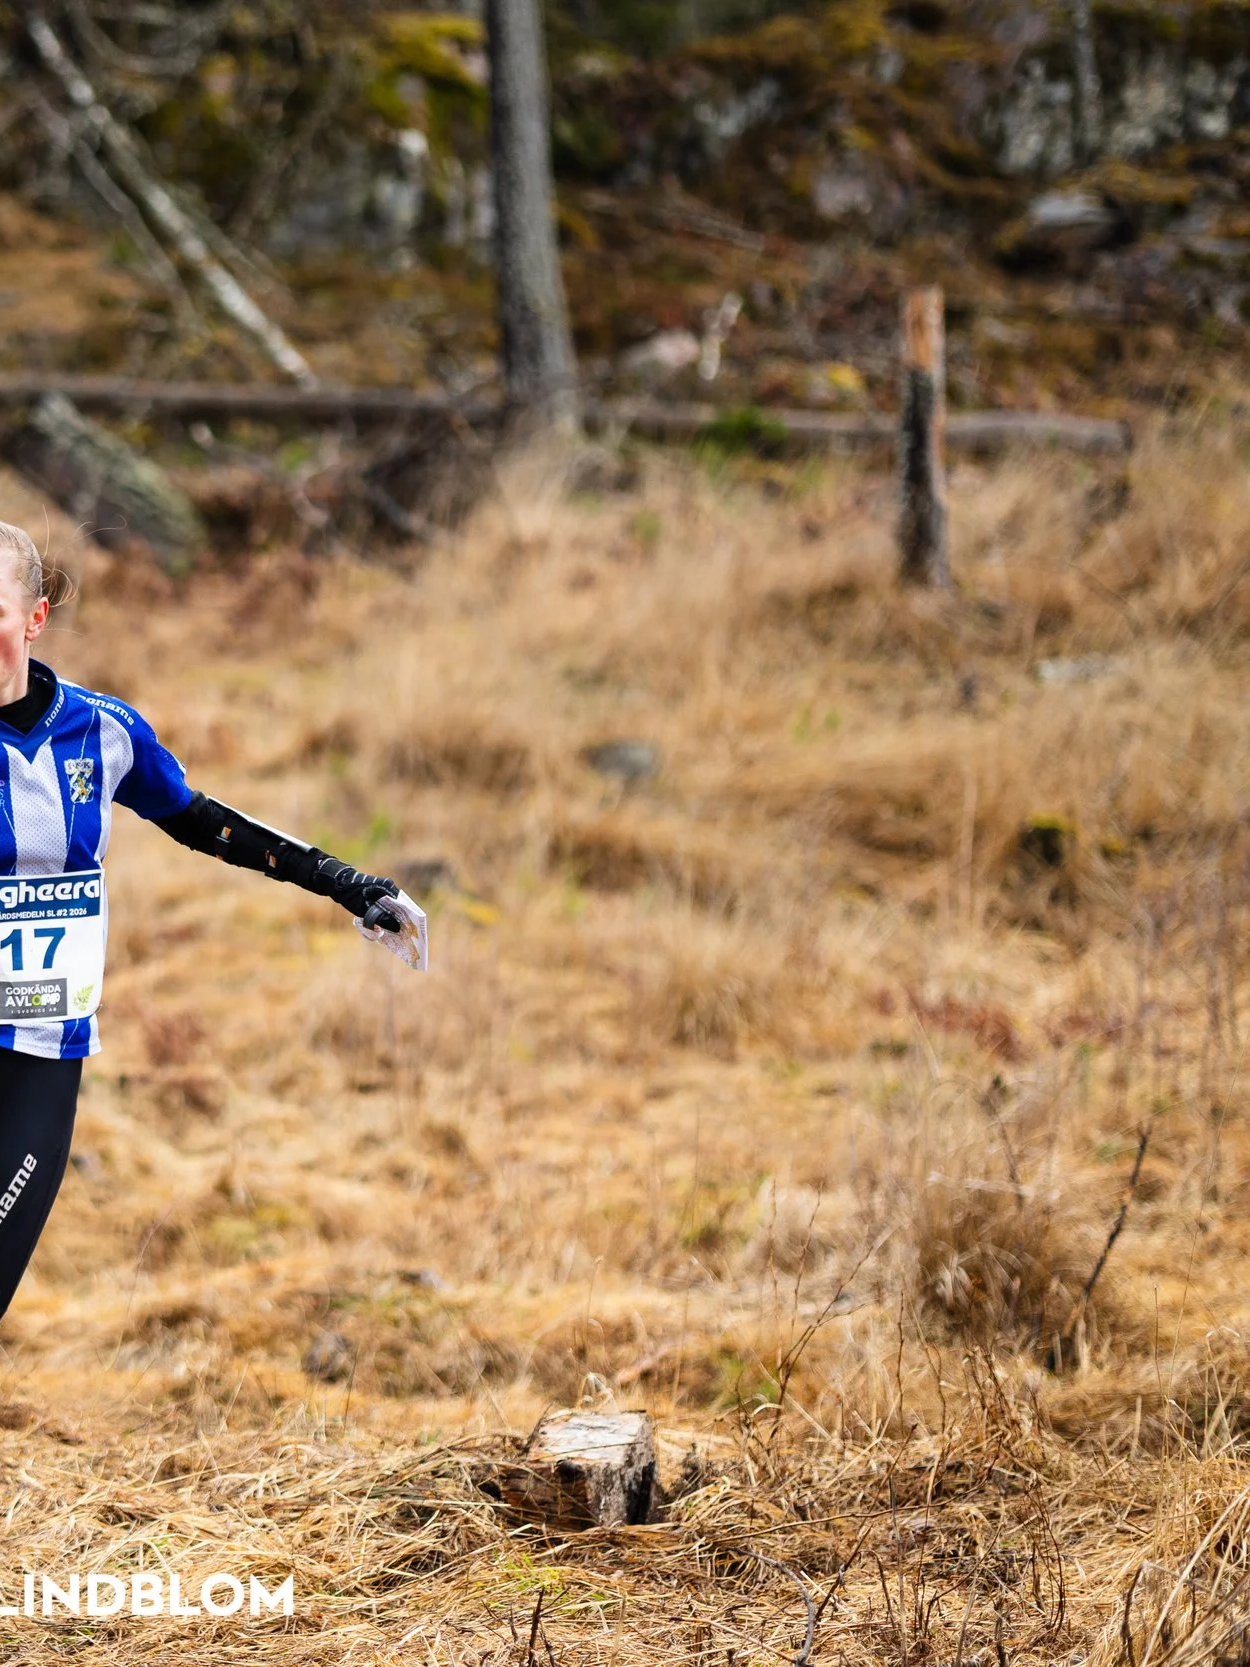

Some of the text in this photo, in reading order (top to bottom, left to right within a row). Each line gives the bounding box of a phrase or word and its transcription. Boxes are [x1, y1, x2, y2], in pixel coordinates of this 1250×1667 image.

[46, 909, 56, 918] SL
[56, 908, 68, 917] #2
[69, 907, 88, 916] 2026
[0, 926, 66, 971] 17
[5, 984, 62, 996] GODKÄNDA
